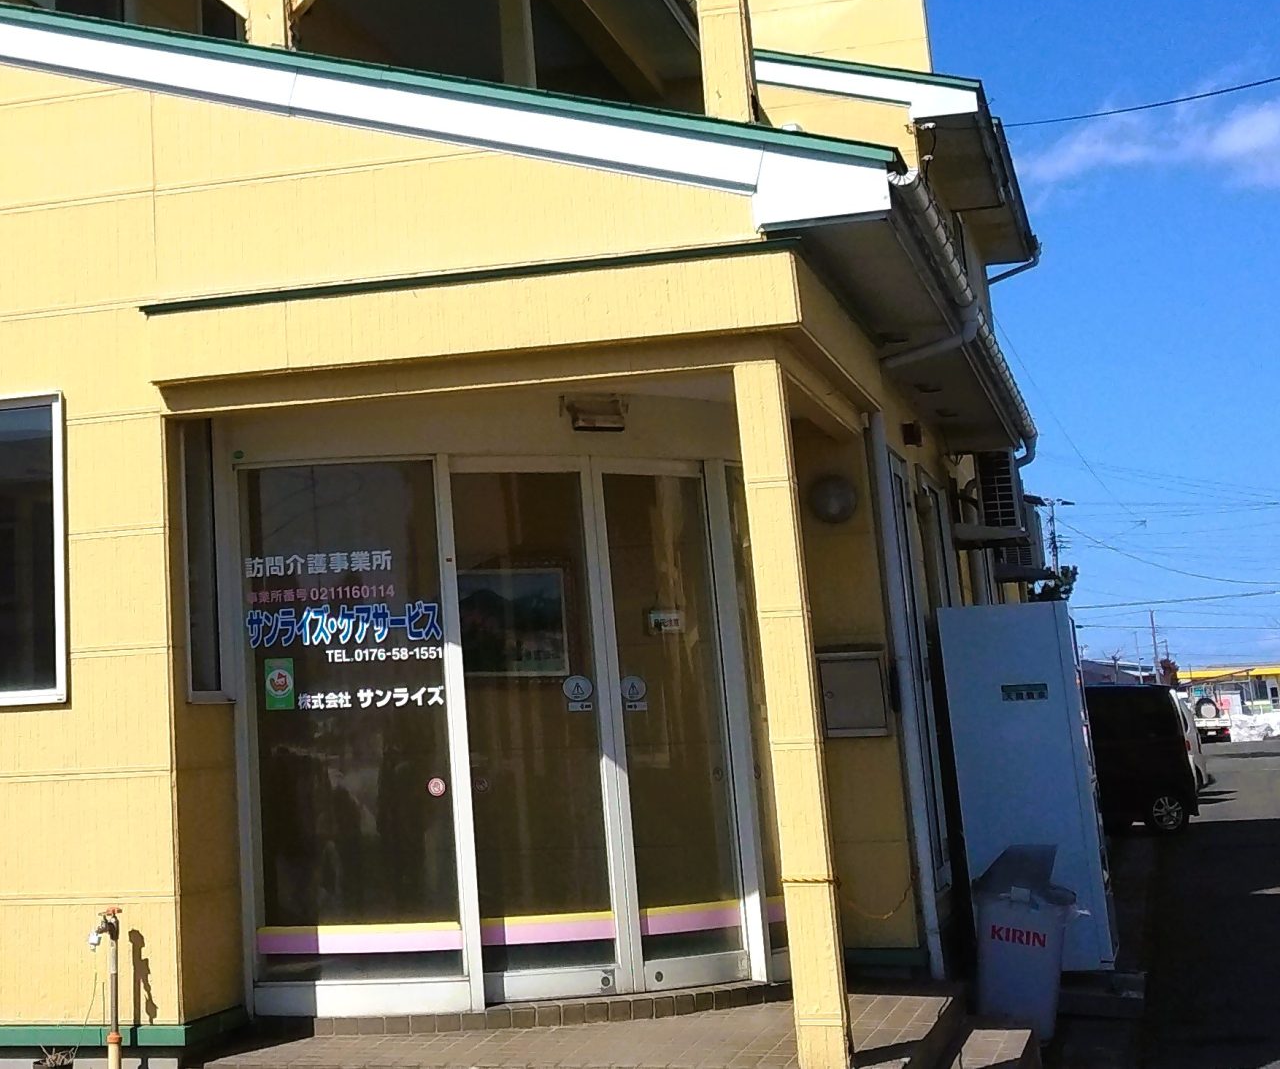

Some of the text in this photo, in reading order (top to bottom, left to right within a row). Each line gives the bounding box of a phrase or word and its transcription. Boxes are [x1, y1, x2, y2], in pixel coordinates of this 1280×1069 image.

[245, 549, 393, 579] 訪問介護事業所
[298, 685, 445, 710] 株式会社 サンライズ
[991, 924, 1047, 948] KIRIN
